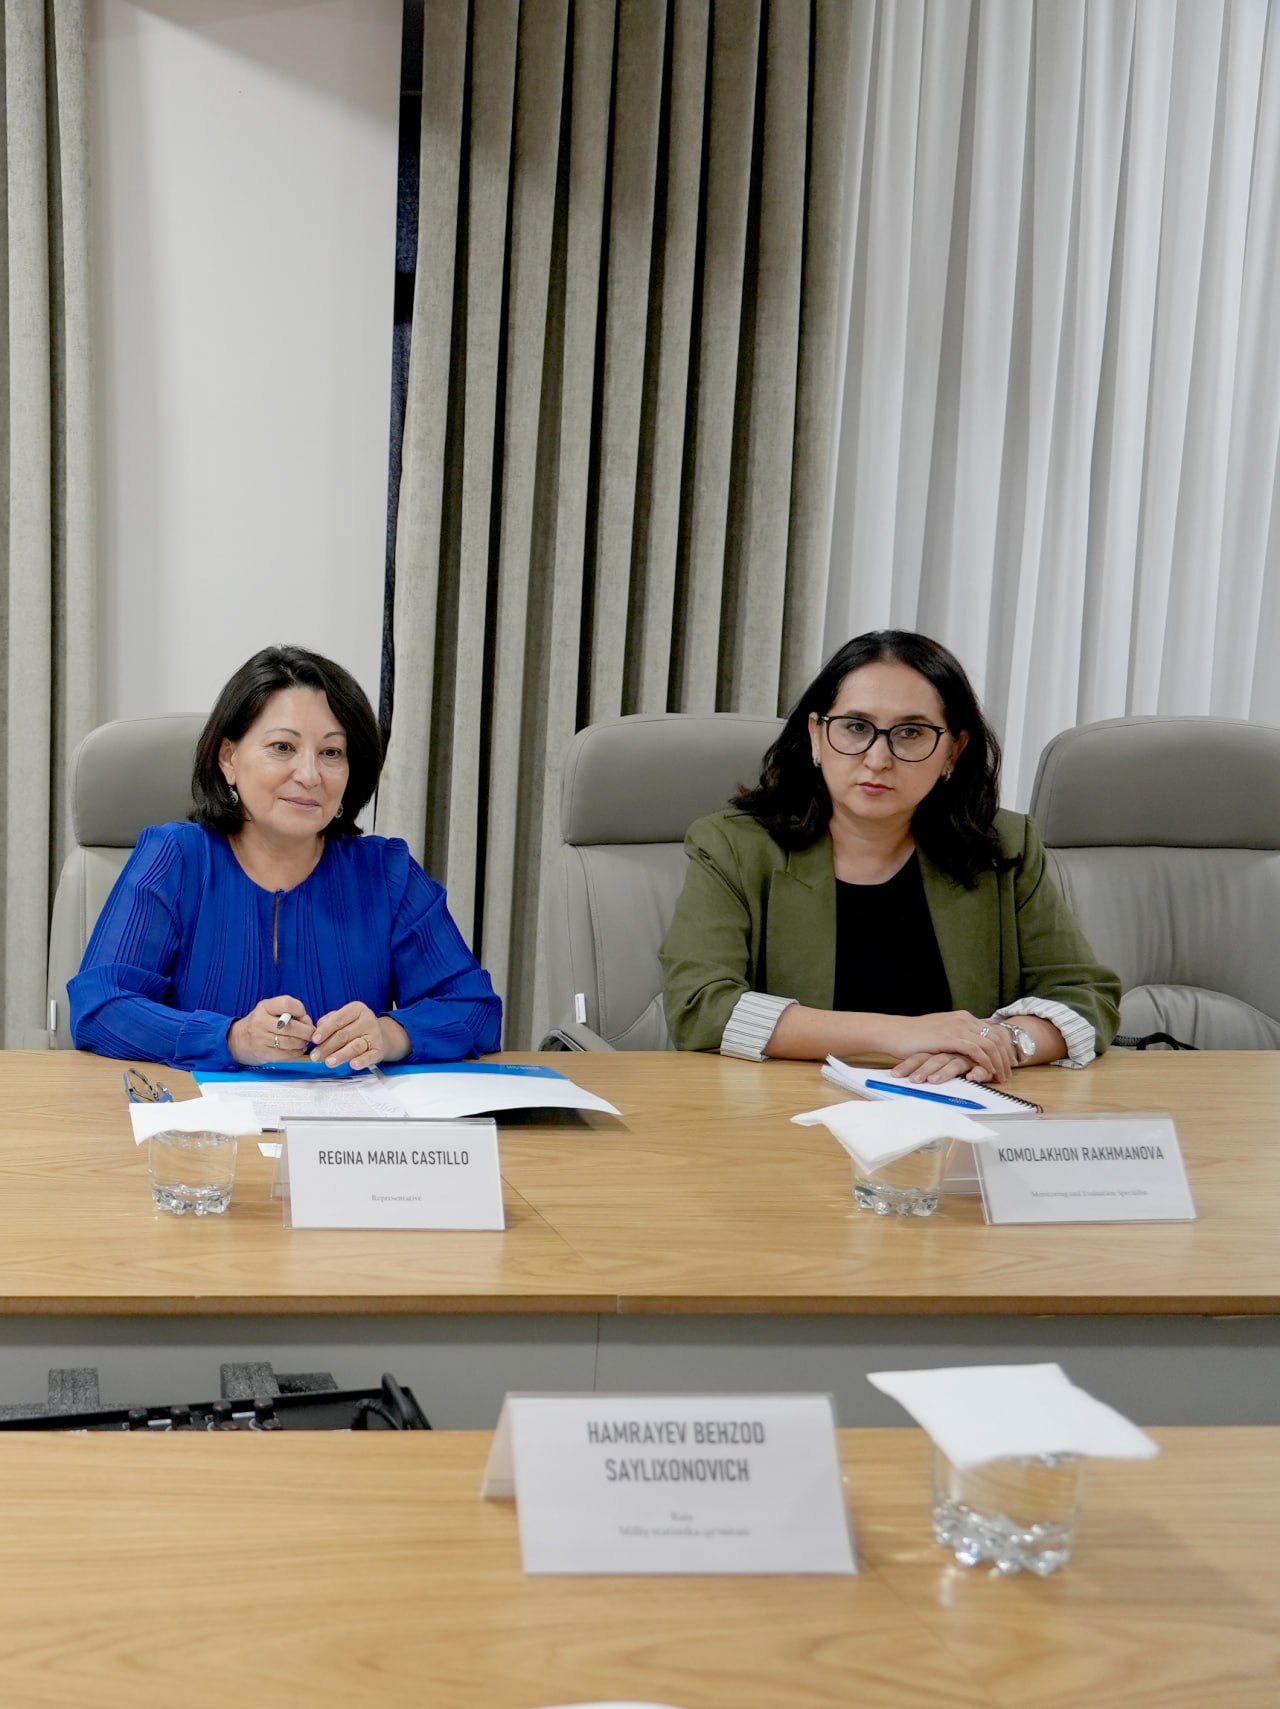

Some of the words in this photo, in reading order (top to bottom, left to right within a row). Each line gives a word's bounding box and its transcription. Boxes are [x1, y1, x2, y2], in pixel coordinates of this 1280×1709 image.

[318, 1150, 364, 1165] REGINA
[367, 1150, 408, 1165] MARIA
[411, 1150, 469, 1166] CASTILLO
[997, 1147, 1079, 1162] KOMOLAKHON
[1082, 1146, 1165, 1161] RAKHMANOVA
[586, 1421, 687, 1445] HAMRAYEV
[694, 1421, 765, 1445] BEHZOD
[605, 1458, 750, 1483] SAYLIXONOVICH
